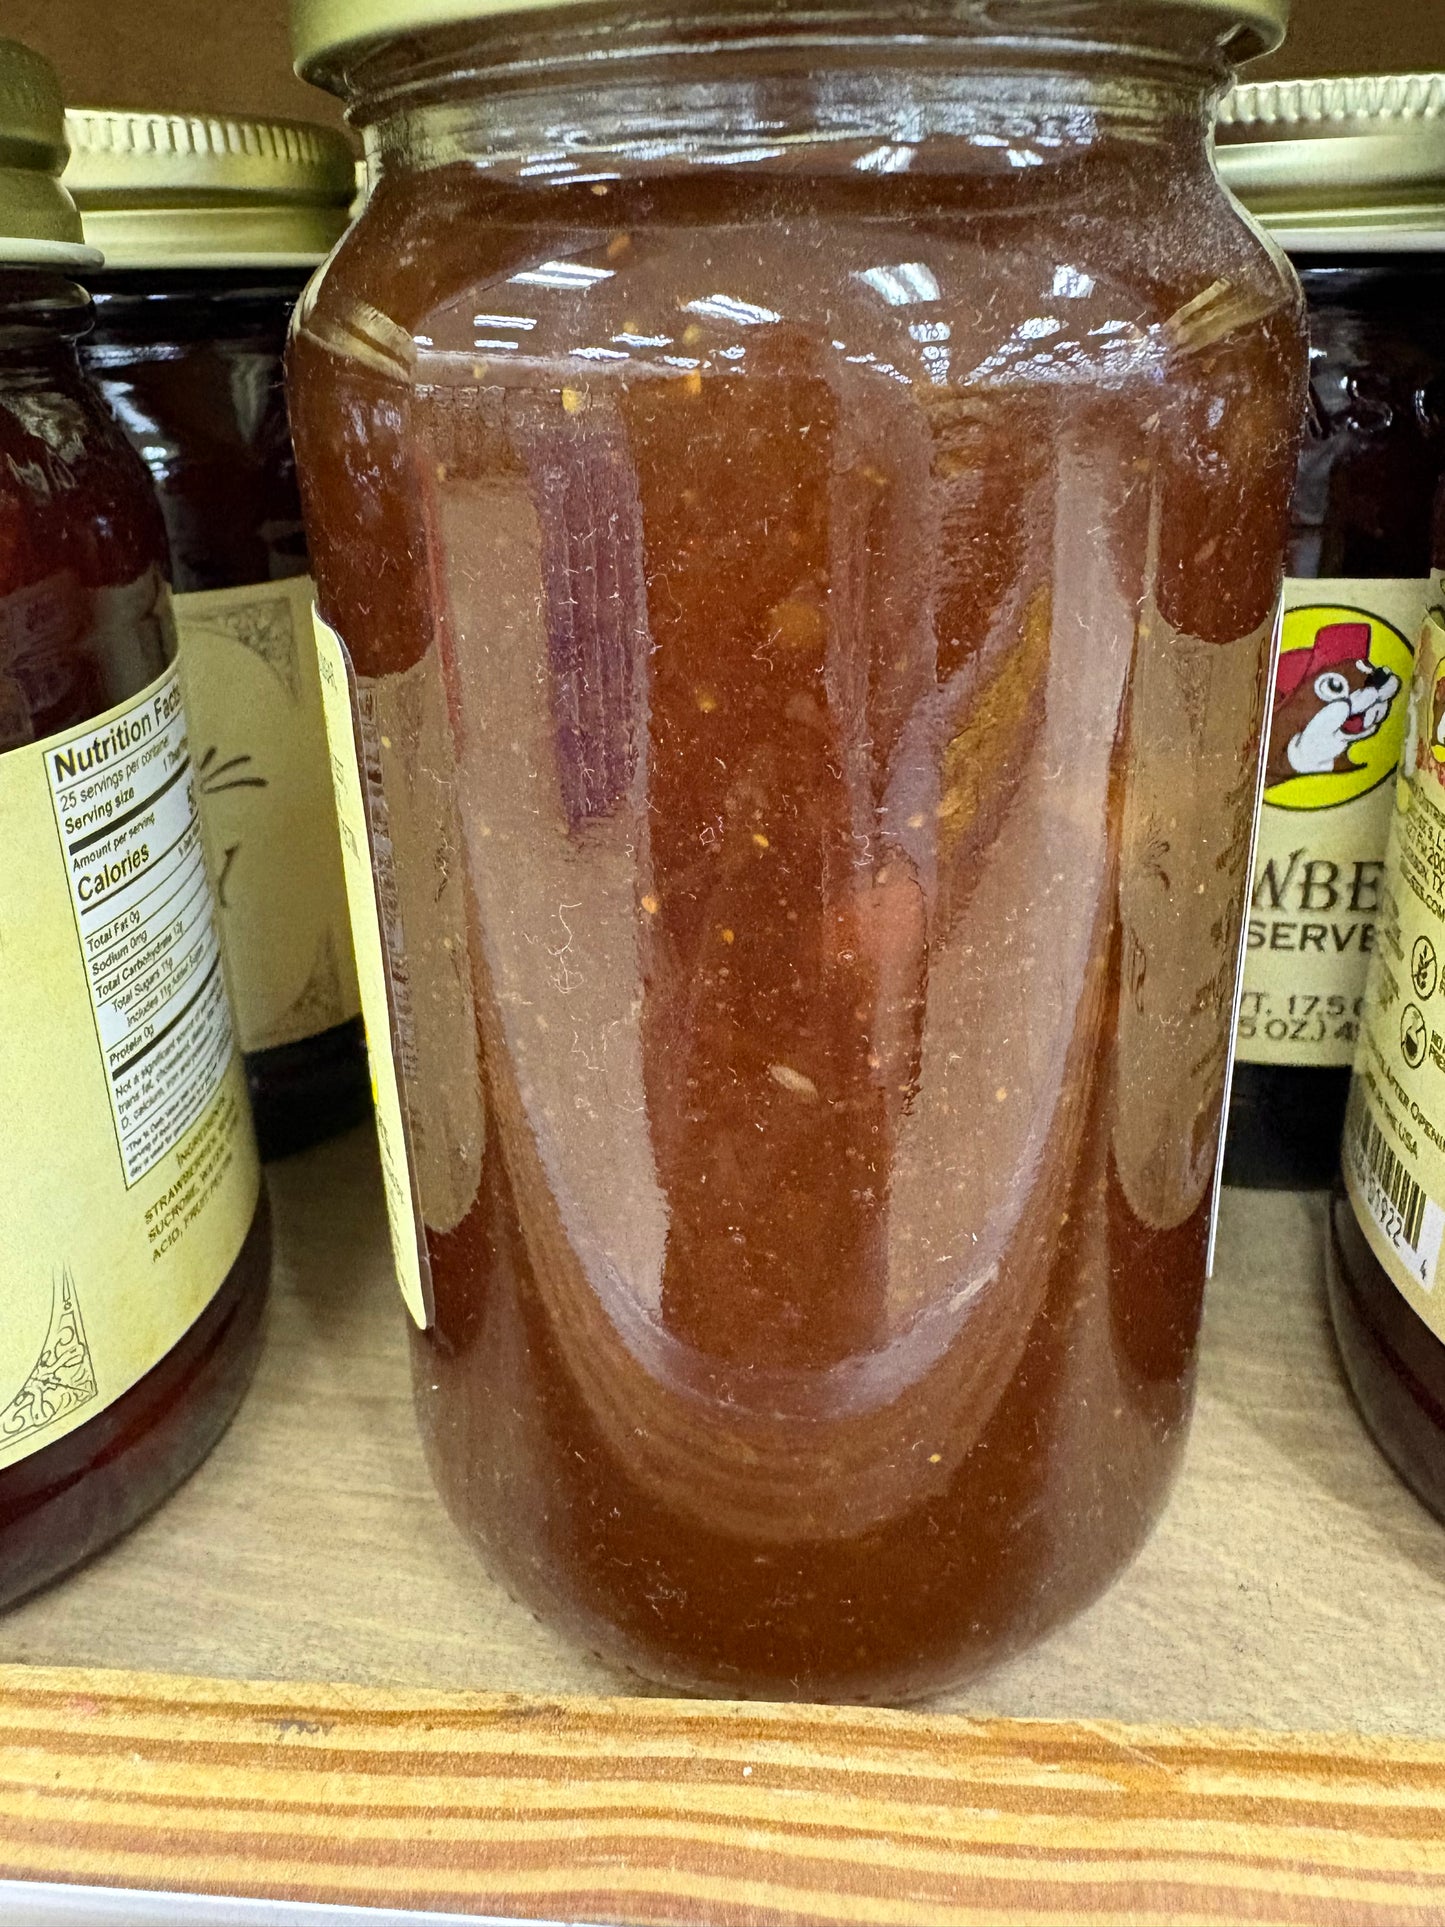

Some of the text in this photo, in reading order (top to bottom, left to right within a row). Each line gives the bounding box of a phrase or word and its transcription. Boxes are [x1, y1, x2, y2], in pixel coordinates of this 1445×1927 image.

[53, 712, 152, 783] Nutrition
[60, 791, 77, 813] 25
[80, 769, 123, 803] servings
[126, 757, 140, 782] per
[64, 786, 135, 835] Serving size
[73, 841, 115, 872] Amount
[113, 834, 128, 852] per
[77, 843, 150, 902] Calories
[86, 932, 113, 953] Total
[114, 918, 129, 935] Fat
[91, 945, 129, 977] Sodium
[95, 976, 121, 999] Total
[110, 990, 133, 1013] Total
[134, 969, 161, 997] Sugars
[109, 1033, 143, 1067] Protein
[115, 1080, 132, 1099] Not
[118, 1090, 141, 1115] trans
